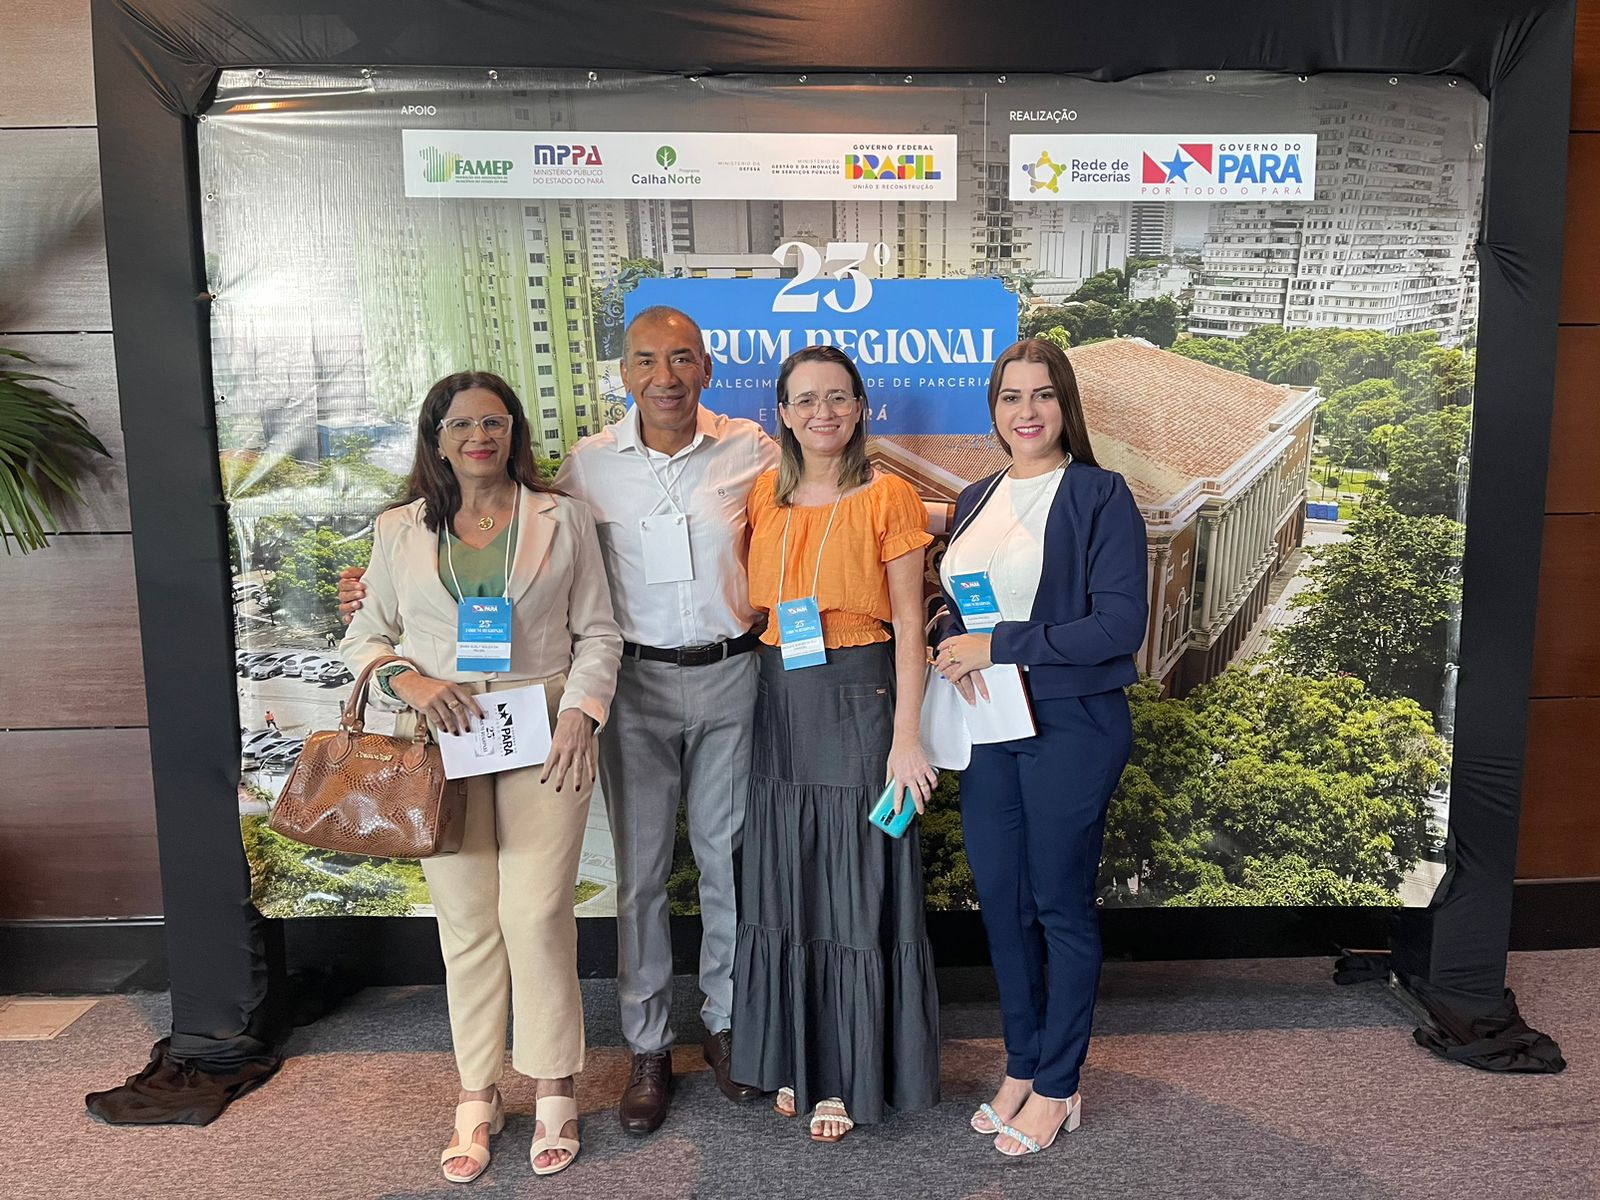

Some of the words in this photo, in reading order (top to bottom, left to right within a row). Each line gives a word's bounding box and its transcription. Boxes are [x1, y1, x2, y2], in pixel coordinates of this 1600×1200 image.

[400, 105, 437, 115] APOIO
[1009, 109, 1078, 123] REALIZAÇÃO
[1219, 143, 1278, 151] GOVERNO
[534, 145, 603, 165] MPPA
[455, 160, 513, 175] FAMEP
[845, 154, 941, 180] BRASIL
[1071, 159, 1108, 170] Rede
[1111, 159, 1129, 170] de
[1218, 153, 1303, 184] PARÁ
[533, 168, 572, 176] MINISTÉRIO
[573, 168, 603, 176] PÚBLICO
[1071, 171, 1131, 182] Parcerias
[1141, 187, 1171, 195] POR
[1185, 186, 1228, 194] TODO
[1262, 185, 1302, 194] PARÁ
[700, 329, 791, 365] RUM
[709, 378, 778, 389] TALECIM
[893, 378, 911, 387] DE
[919, 377, 991, 387] PARCERIA
